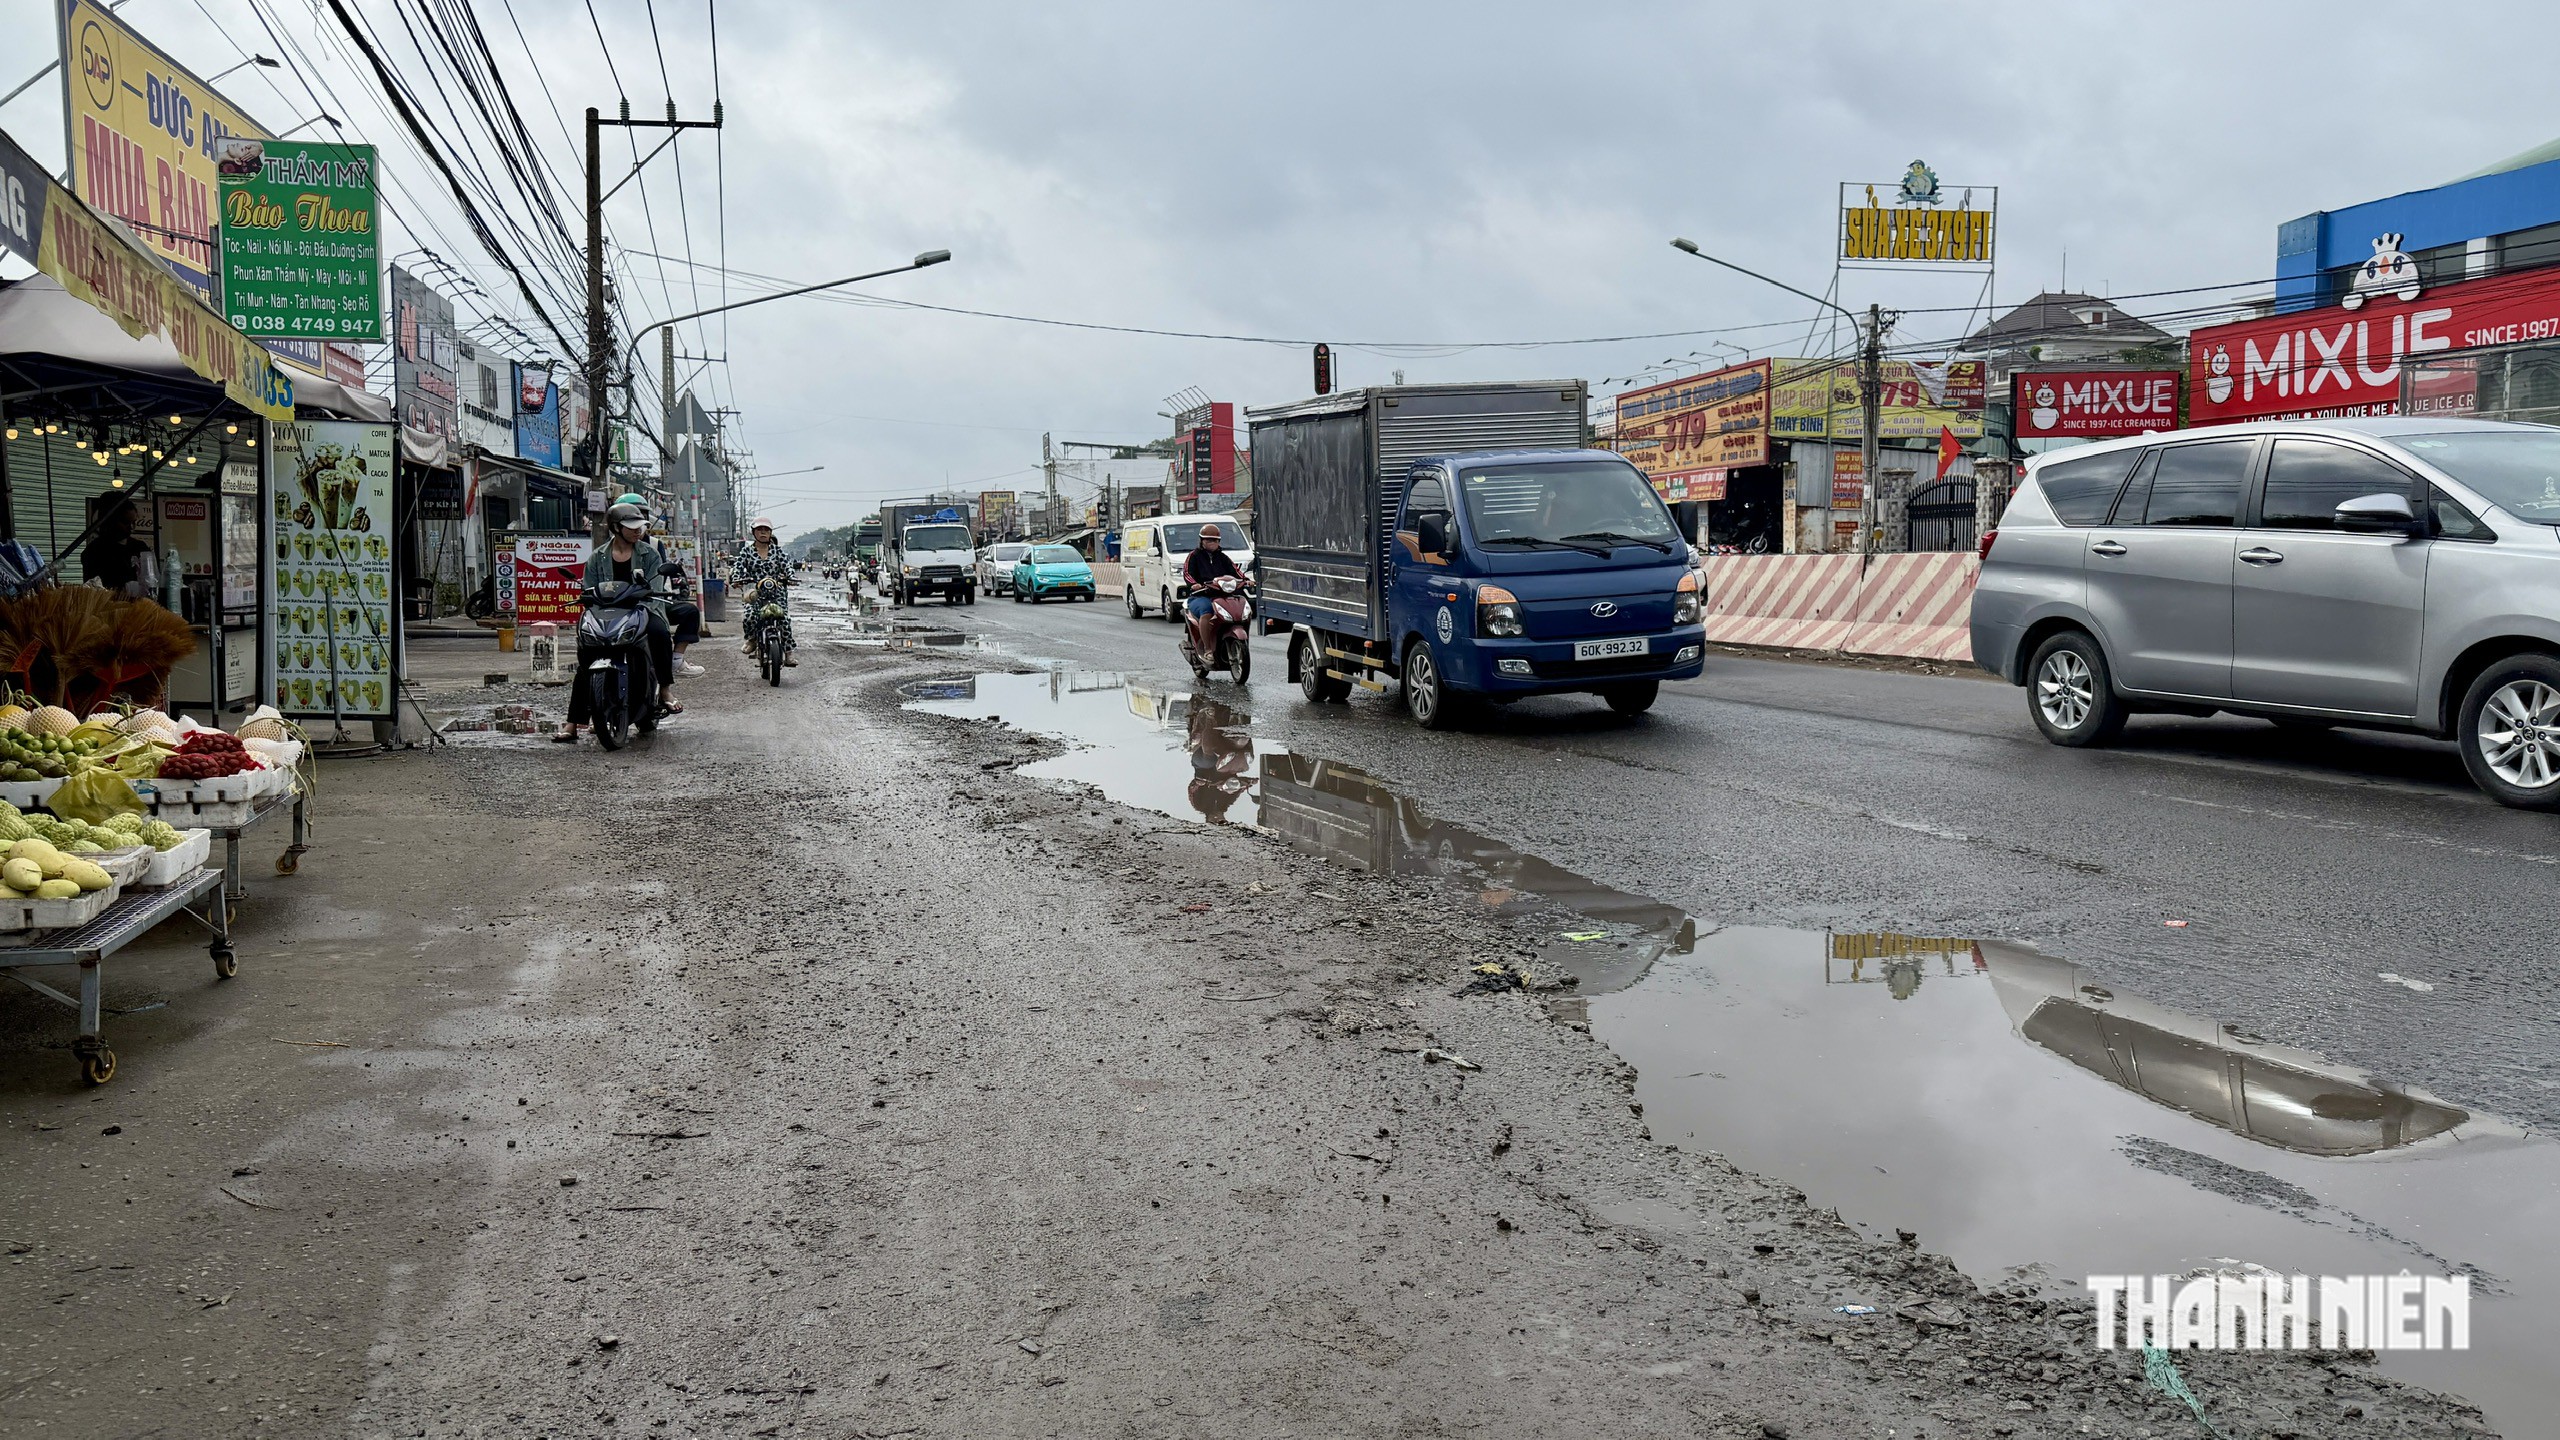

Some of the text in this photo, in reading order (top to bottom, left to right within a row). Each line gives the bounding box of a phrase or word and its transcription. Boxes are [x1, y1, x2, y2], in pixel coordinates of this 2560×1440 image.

[145, 69, 194, 148] ĐỨC
[264, 150, 370, 188] THẨM MỸ
[84, 113, 211, 270] MUA BÁN
[226, 190, 372, 234] Bảo Thoa
[1845, 184, 1890, 258] SỬA
[1893, 209, 1922, 259] XE
[1924, 210, 1966, 260] 379
[225, 238, 240, 254] Tóc
[247, 238, 262, 254] Nail
[268, 238, 282, 254] Nối
[284, 240, 292, 256] Mi
[358, 244, 374, 259] Sinh
[234, 265, 254, 281] Phun
[256, 266, 273, 281] Xăm
[275, 263, 296, 282] Thẩm
[299, 267, 309, 287] Mỹ
[316, 269, 331, 288] Mày
[338, 268, 352, 285] Môi
[235, 292, 246, 310] Trị
[248, 293, 263, 311] Mụn
[271, 293, 288, 309] Nám
[295, 293, 309, 309] Tàn
[312, 295, 336, 314] Nhang
[342, 296, 357, 315] Sẹo
[252, 316, 374, 333] 038 4749 947
[2464, 324, 2518, 346] SINCE
[2243, 308, 2452, 402] MIXUE
[2063, 379, 2173, 415] MIXUE
[2316, 409, 2337, 419] YOU
[2372, 403, 2387, 415] ME
[2435, 396, 2453, 410] ICE
[1662, 411, 1706, 452] 379
[1774, 413, 1824, 432] THAY BÌNH
[2063, 420, 2086, 429] SINCE
[2124, 418, 2171, 428] CREAM&TEA
[520, 581, 560, 589] THANH
[525, 592, 540, 601] SỬA
[1581, 641, 1642, 656] 60K-992.32
